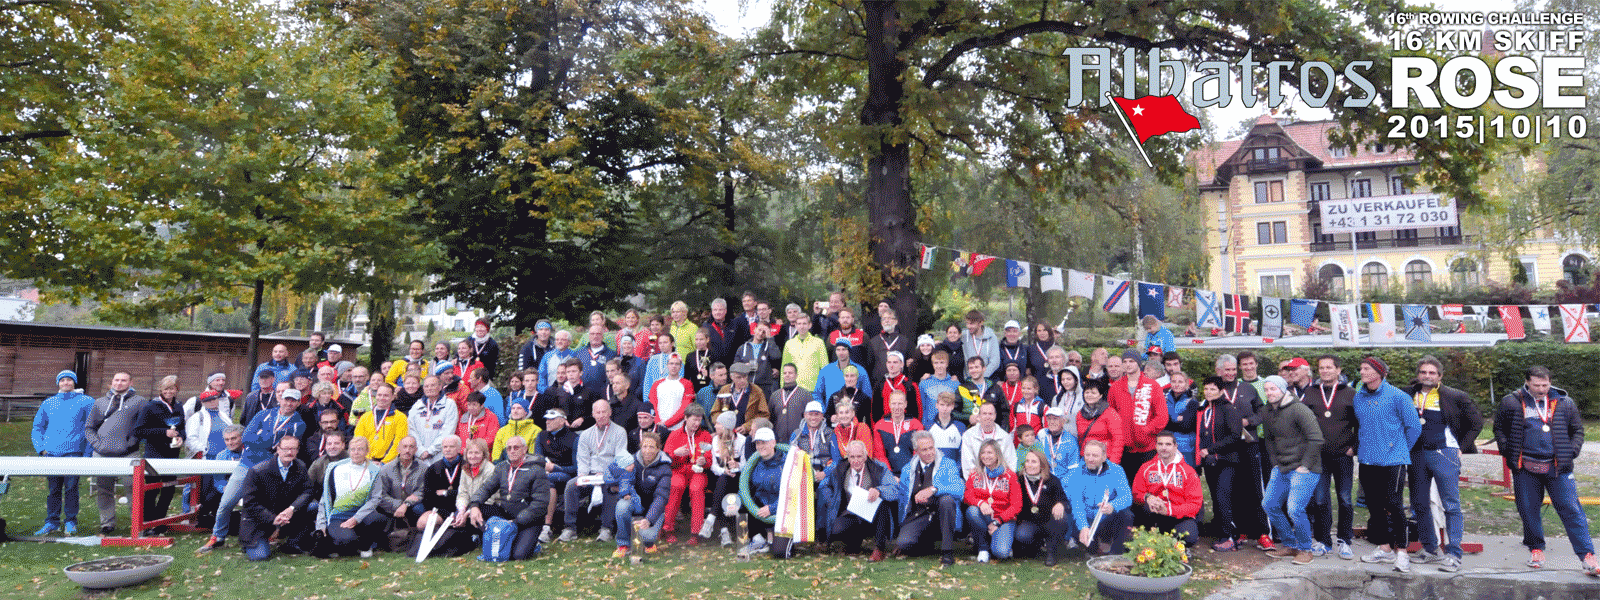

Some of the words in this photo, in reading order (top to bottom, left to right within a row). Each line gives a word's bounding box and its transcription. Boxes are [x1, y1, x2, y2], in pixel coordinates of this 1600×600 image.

[1328, 204, 1348, 215] ZU
[1361, 216, 1367, 226] 1
[1374, 214, 1391, 226] 31
[1396, 212, 1416, 224] 72
[1420, 210, 1448, 222] 030
